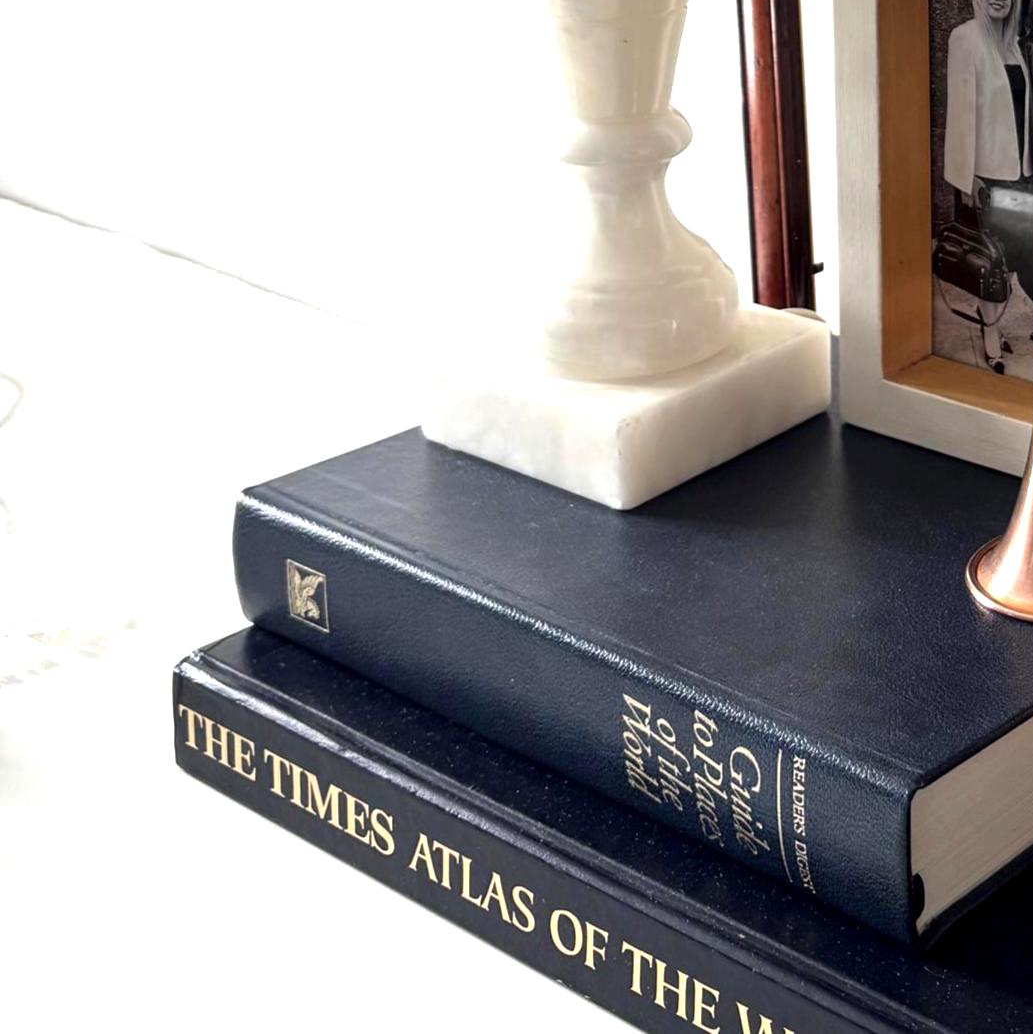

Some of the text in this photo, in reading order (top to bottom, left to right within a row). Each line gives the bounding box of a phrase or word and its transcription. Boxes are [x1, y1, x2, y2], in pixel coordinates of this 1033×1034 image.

[622, 693, 663, 804] World
[648, 718, 693, 812] of the
[693, 709, 728, 848] to Places
[729, 746, 770, 855] Guide
[178, 704, 721, 1034] THE TIMES ATLAS OF THE
